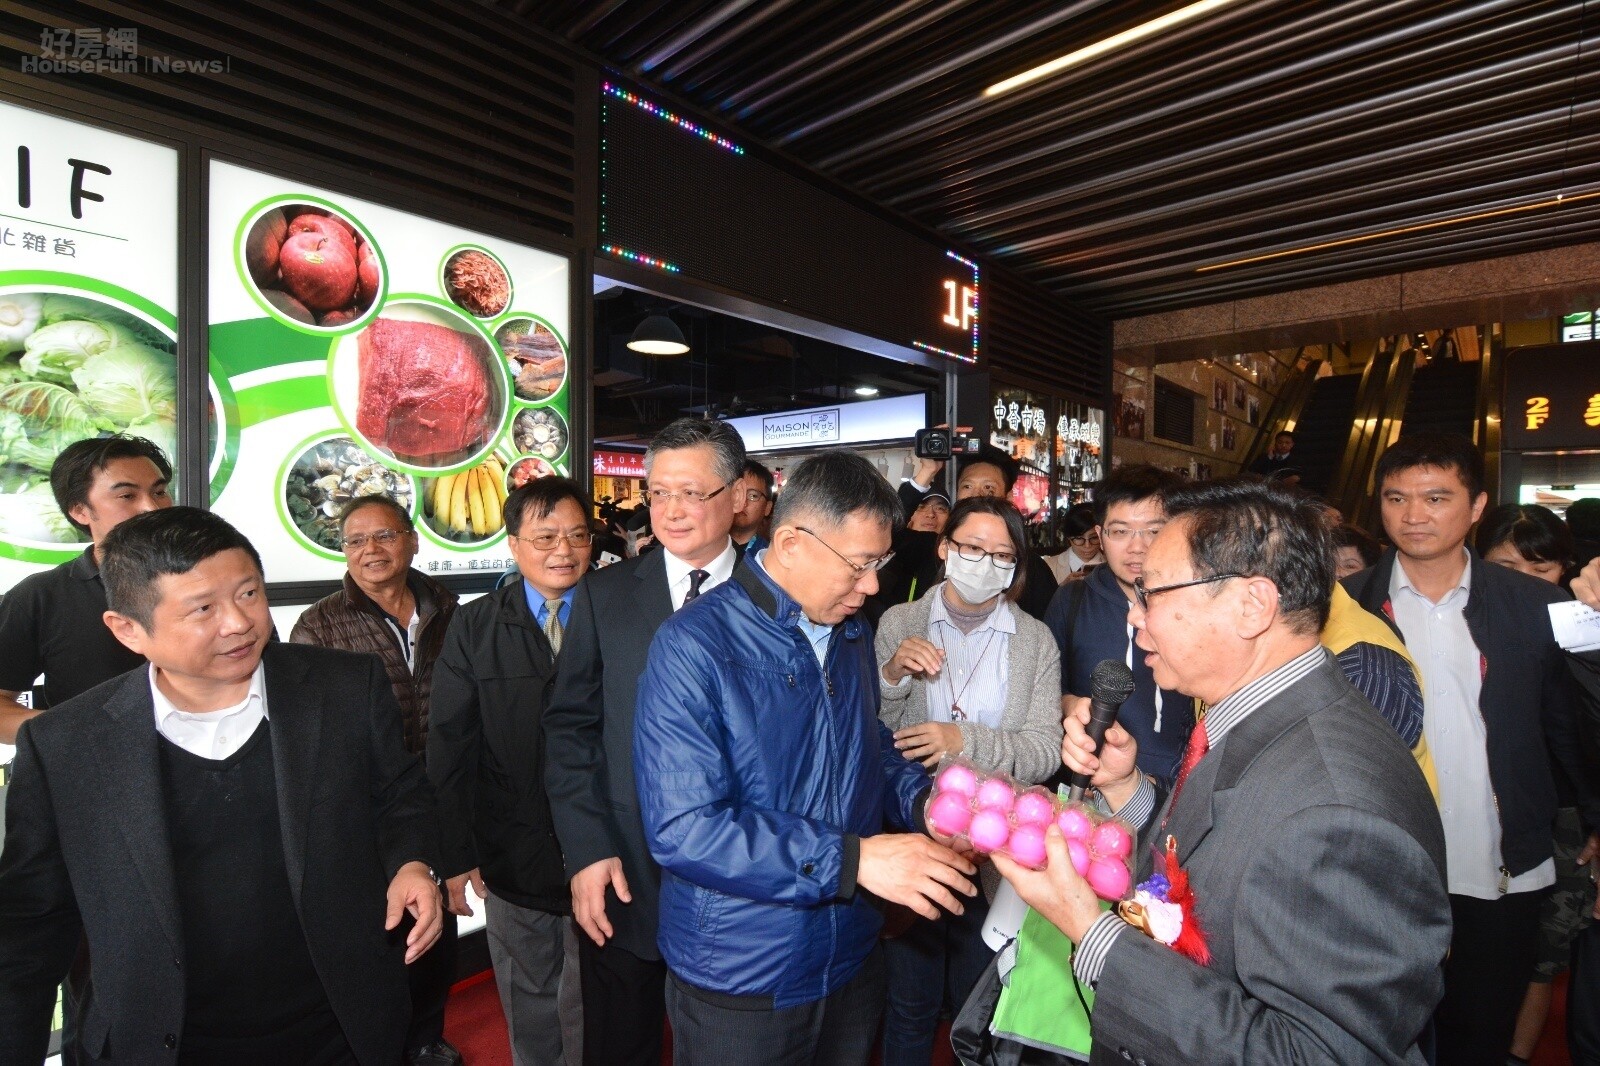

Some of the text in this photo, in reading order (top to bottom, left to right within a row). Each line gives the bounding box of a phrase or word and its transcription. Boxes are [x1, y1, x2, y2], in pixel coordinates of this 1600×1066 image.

[943, 280, 978, 330] 1F
[994, 398, 1046, 436] 中崙市場
